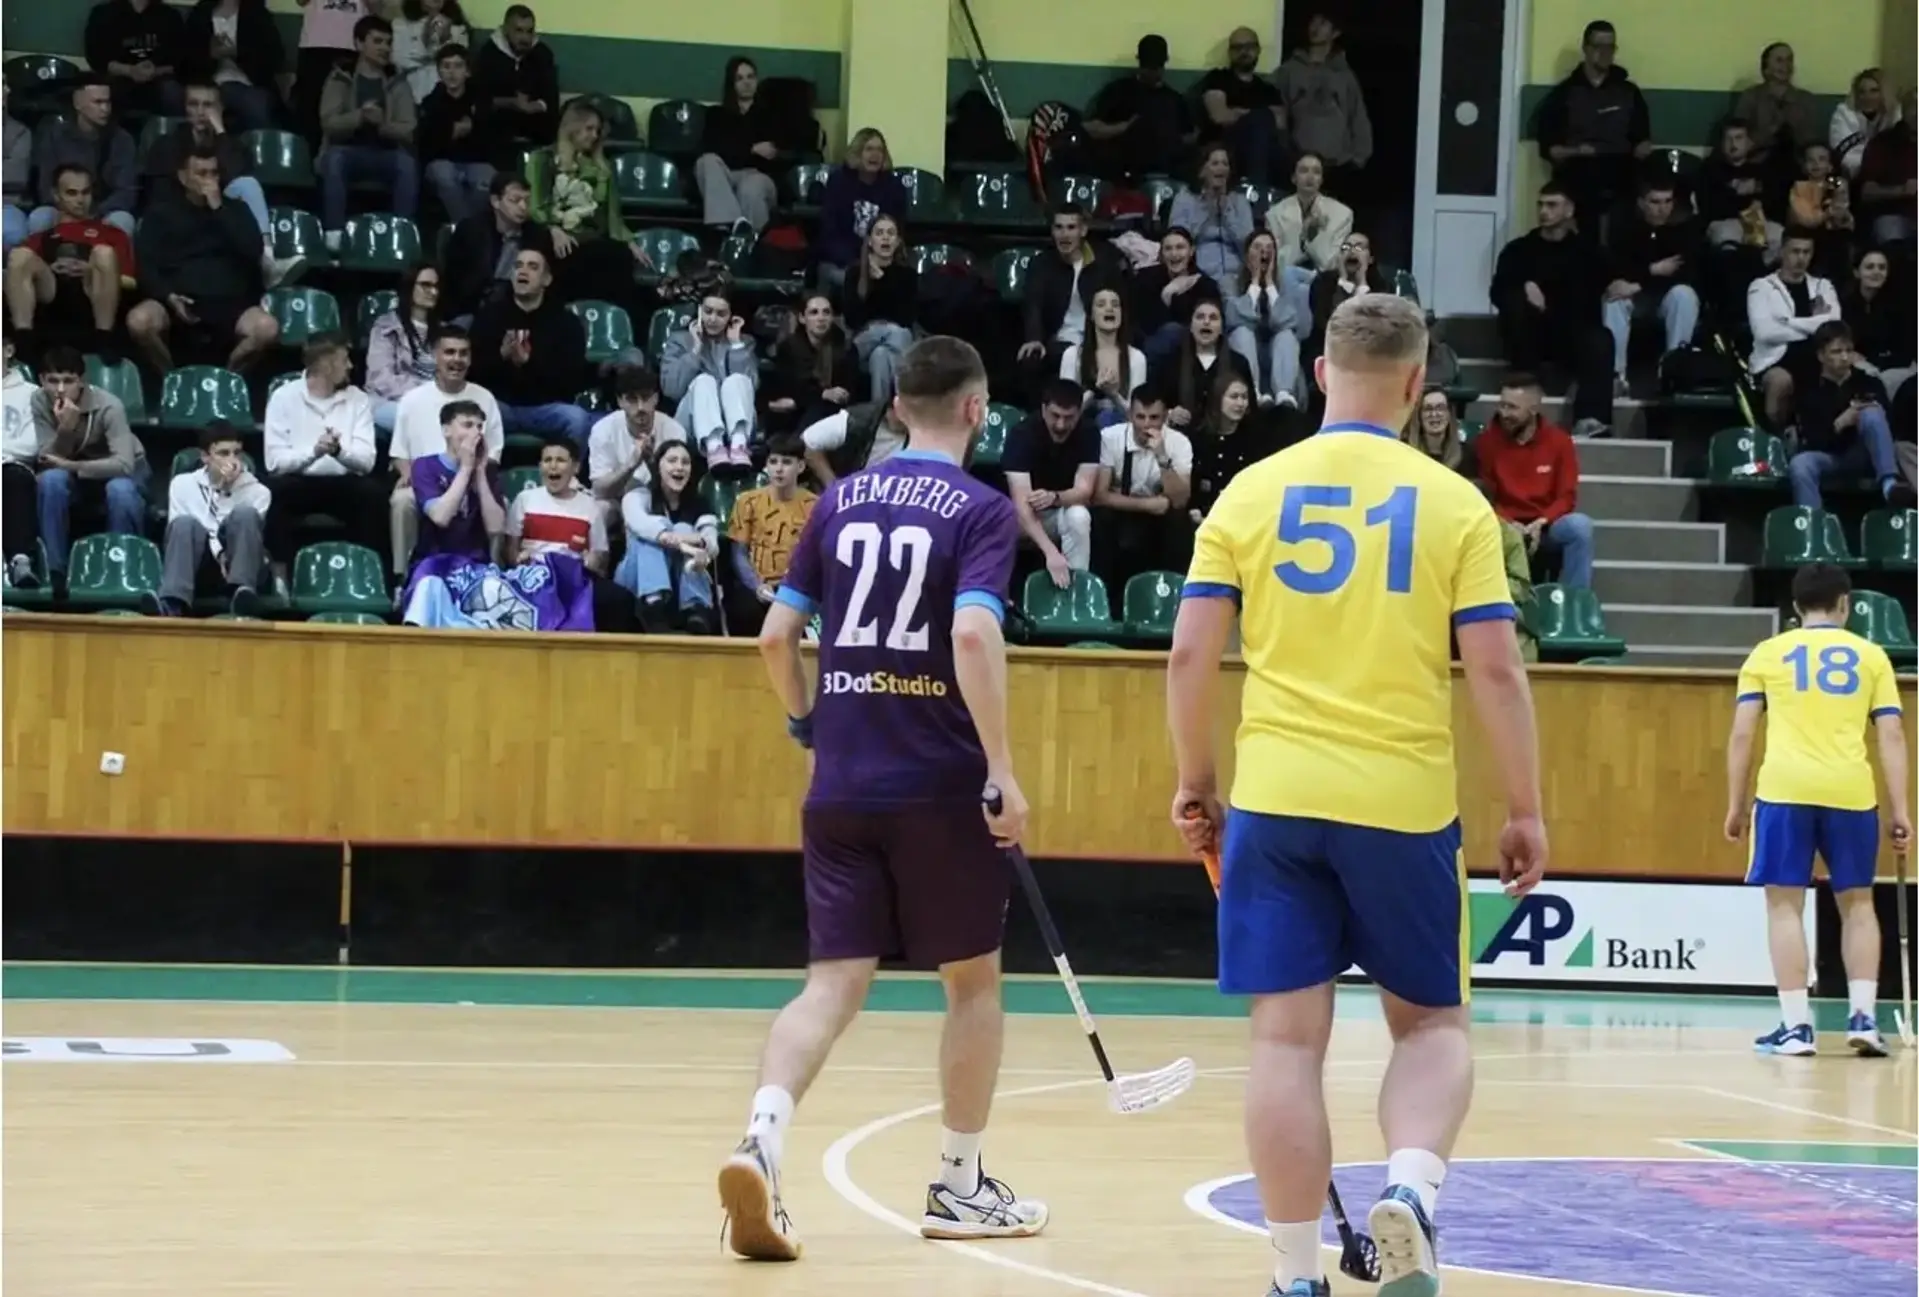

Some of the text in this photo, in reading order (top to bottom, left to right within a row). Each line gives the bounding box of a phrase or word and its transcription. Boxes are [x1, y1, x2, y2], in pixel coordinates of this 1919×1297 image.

[836, 473, 969, 519] LEMBERG
[1273, 485, 1417, 595] 51
[834, 522, 933, 652] 22
[823, 670, 947, 697] 3DotStudio
[1782, 645, 1860, 695] 18
[1475, 894, 1697, 970] AP Bank
